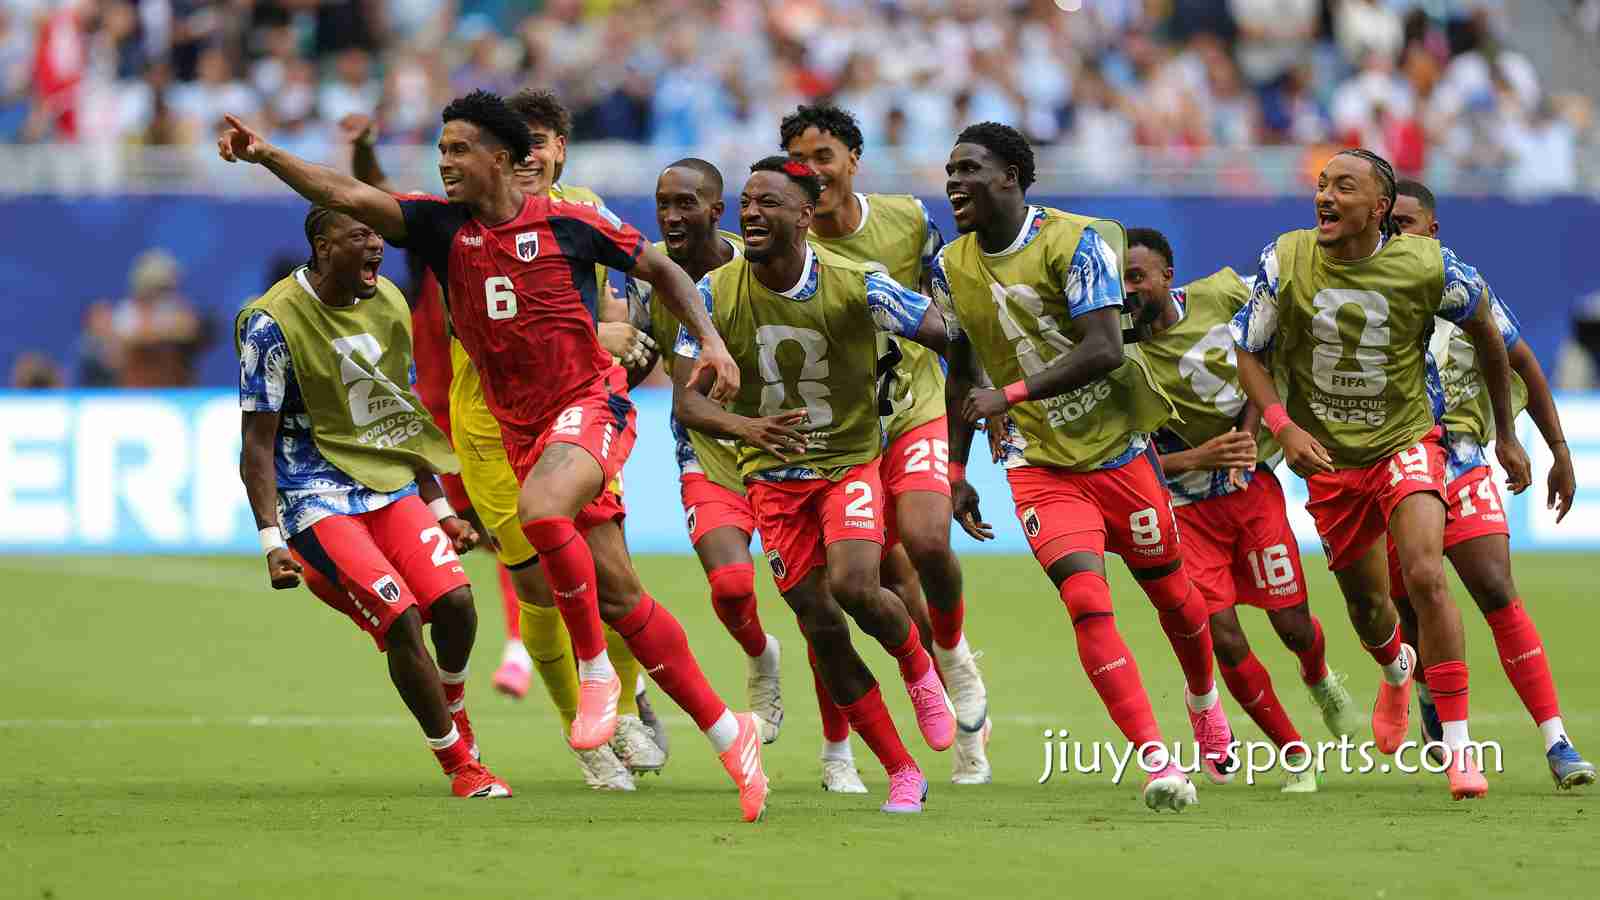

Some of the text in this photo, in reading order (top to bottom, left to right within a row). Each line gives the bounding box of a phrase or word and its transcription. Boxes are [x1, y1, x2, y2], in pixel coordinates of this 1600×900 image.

[485, 276, 518, 320] 6
[1331, 375, 1367, 388] FIFA
[1047, 384, 1112, 427] 2026
[1309, 402, 1387, 426] 2026
[904, 438, 949, 474] 25
[1389, 442, 1428, 487] 19
[845, 481, 874, 519] 2
[1458, 475, 1501, 518] 14
[1129, 507, 1161, 545] 8
[1248, 543, 1295, 589] 16
